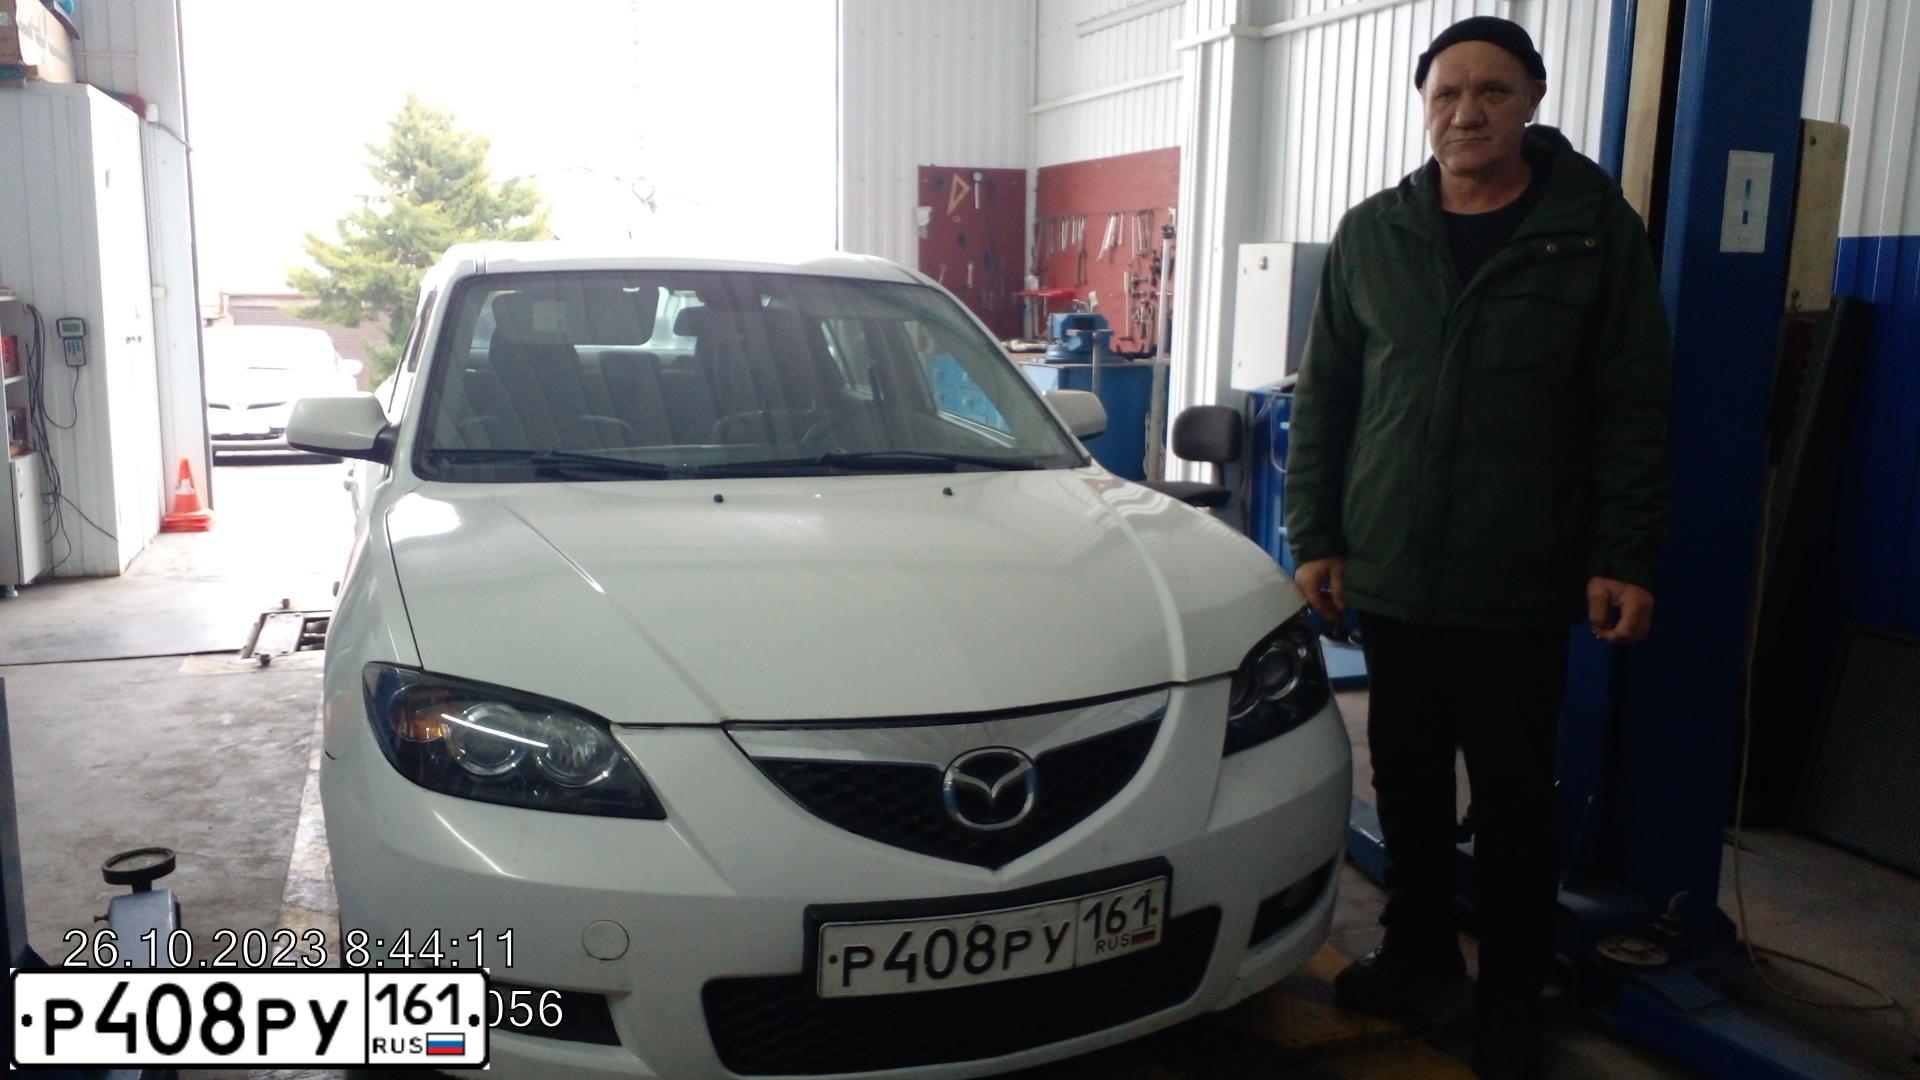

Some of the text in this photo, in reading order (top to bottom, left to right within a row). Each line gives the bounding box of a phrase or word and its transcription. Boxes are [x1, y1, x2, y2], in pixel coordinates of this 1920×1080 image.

[842, 888, 1152, 988] Р408РУ 161
[1095, 932, 1130, 955] RUS
